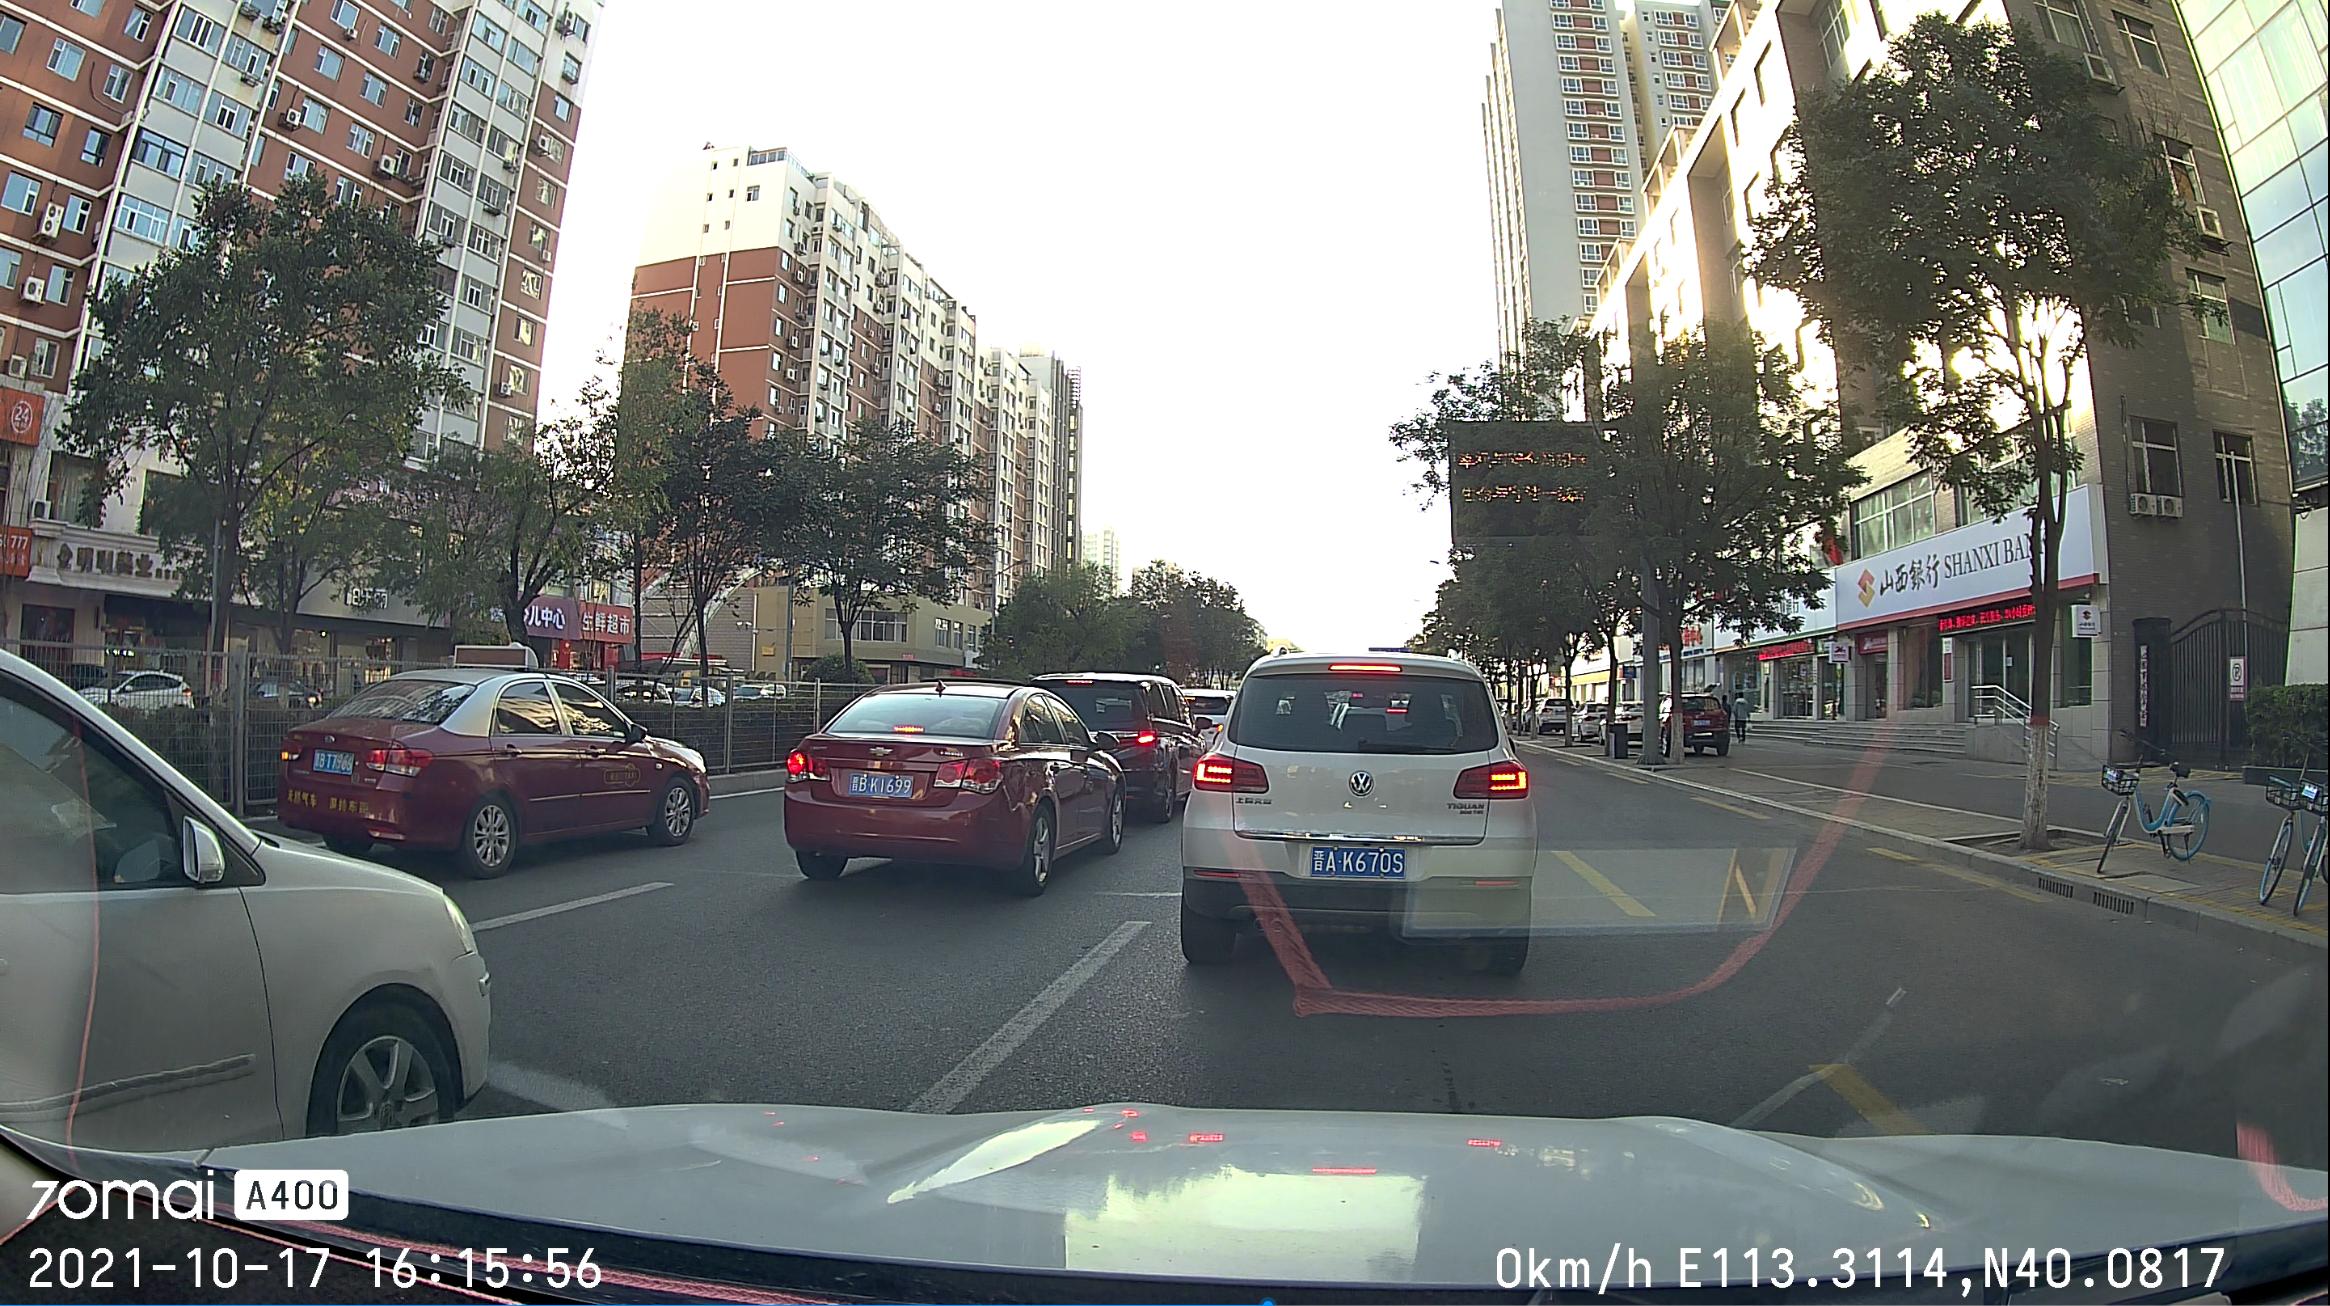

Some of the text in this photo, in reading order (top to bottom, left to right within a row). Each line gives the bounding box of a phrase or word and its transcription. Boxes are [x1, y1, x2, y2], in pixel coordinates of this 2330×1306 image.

[1944, 541, 2000, 579] SHANXI
[582, 612, 631, 635] 生鲜超市
